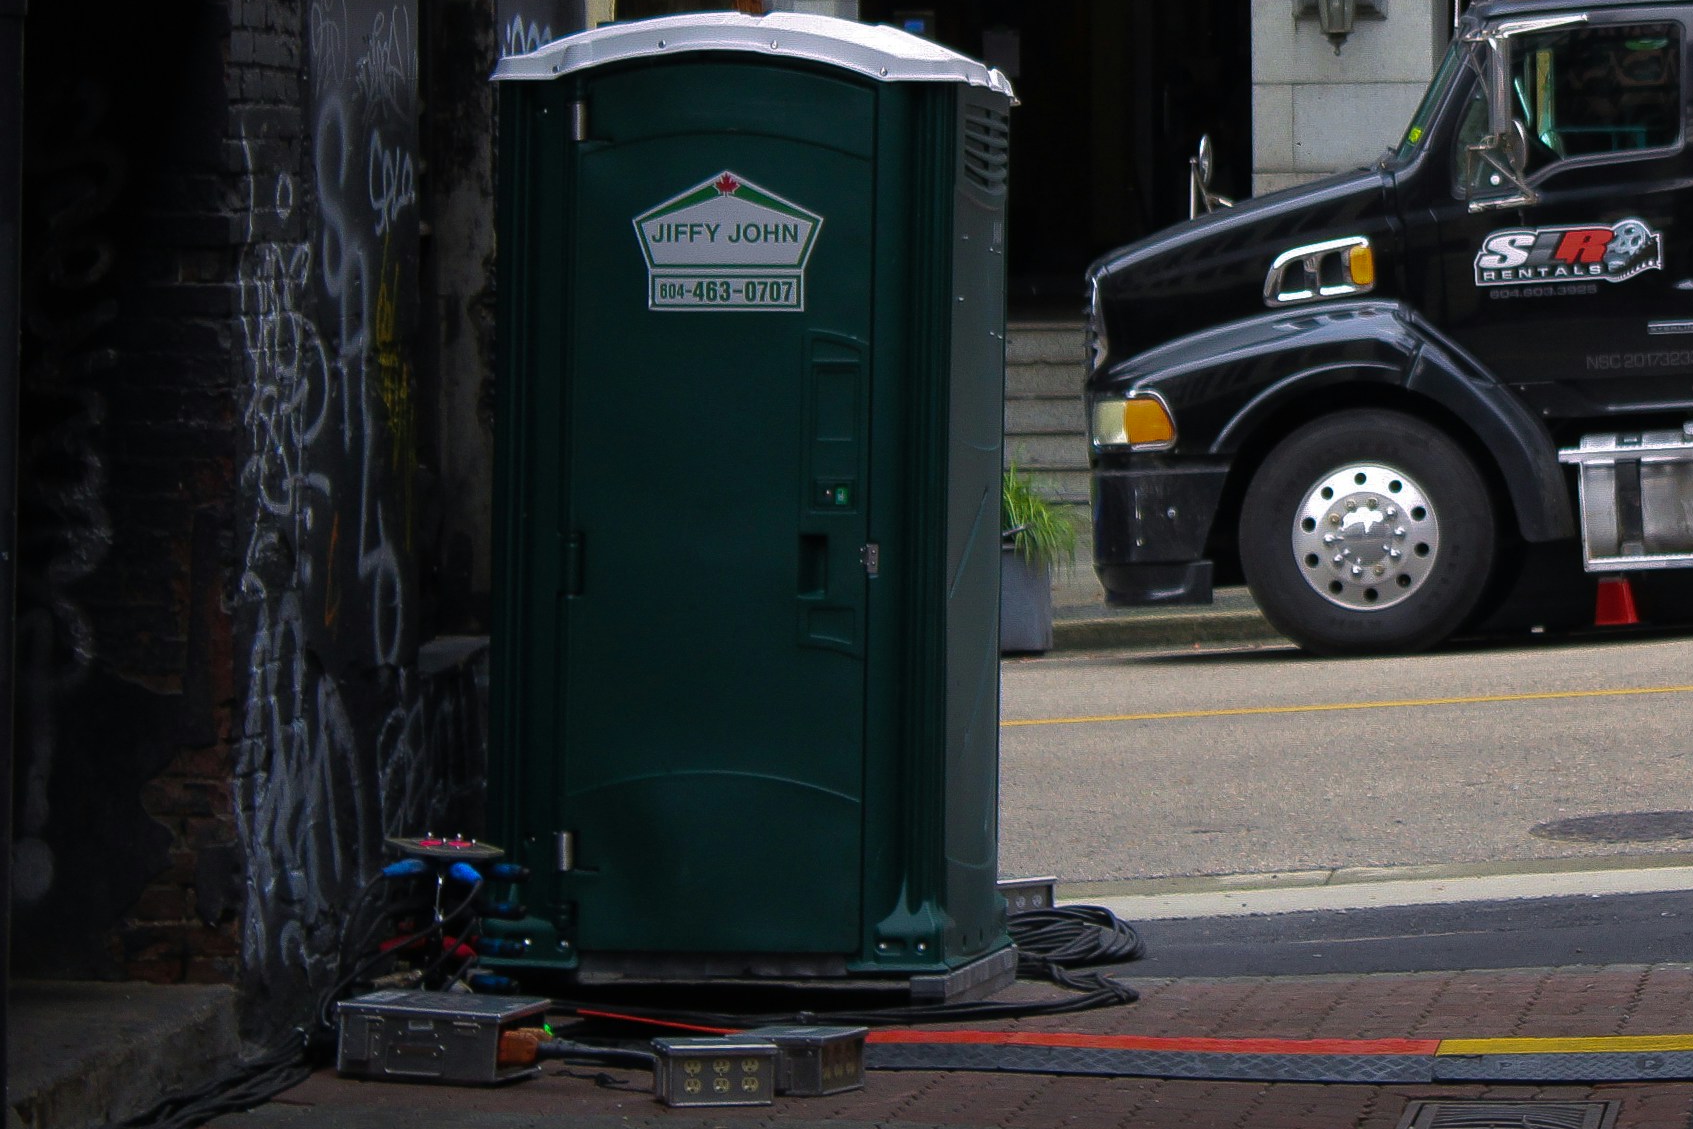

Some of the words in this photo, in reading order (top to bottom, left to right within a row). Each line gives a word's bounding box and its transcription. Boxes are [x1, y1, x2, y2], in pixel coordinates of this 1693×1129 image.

[651, 223, 721, 244] JIFFY
[728, 223, 799, 244] JOHN
[1483, 265, 1602, 281] RENTALS
[659, 280, 793, 302] 604-463-0707
[1586, 354, 1622, 370] NSC
